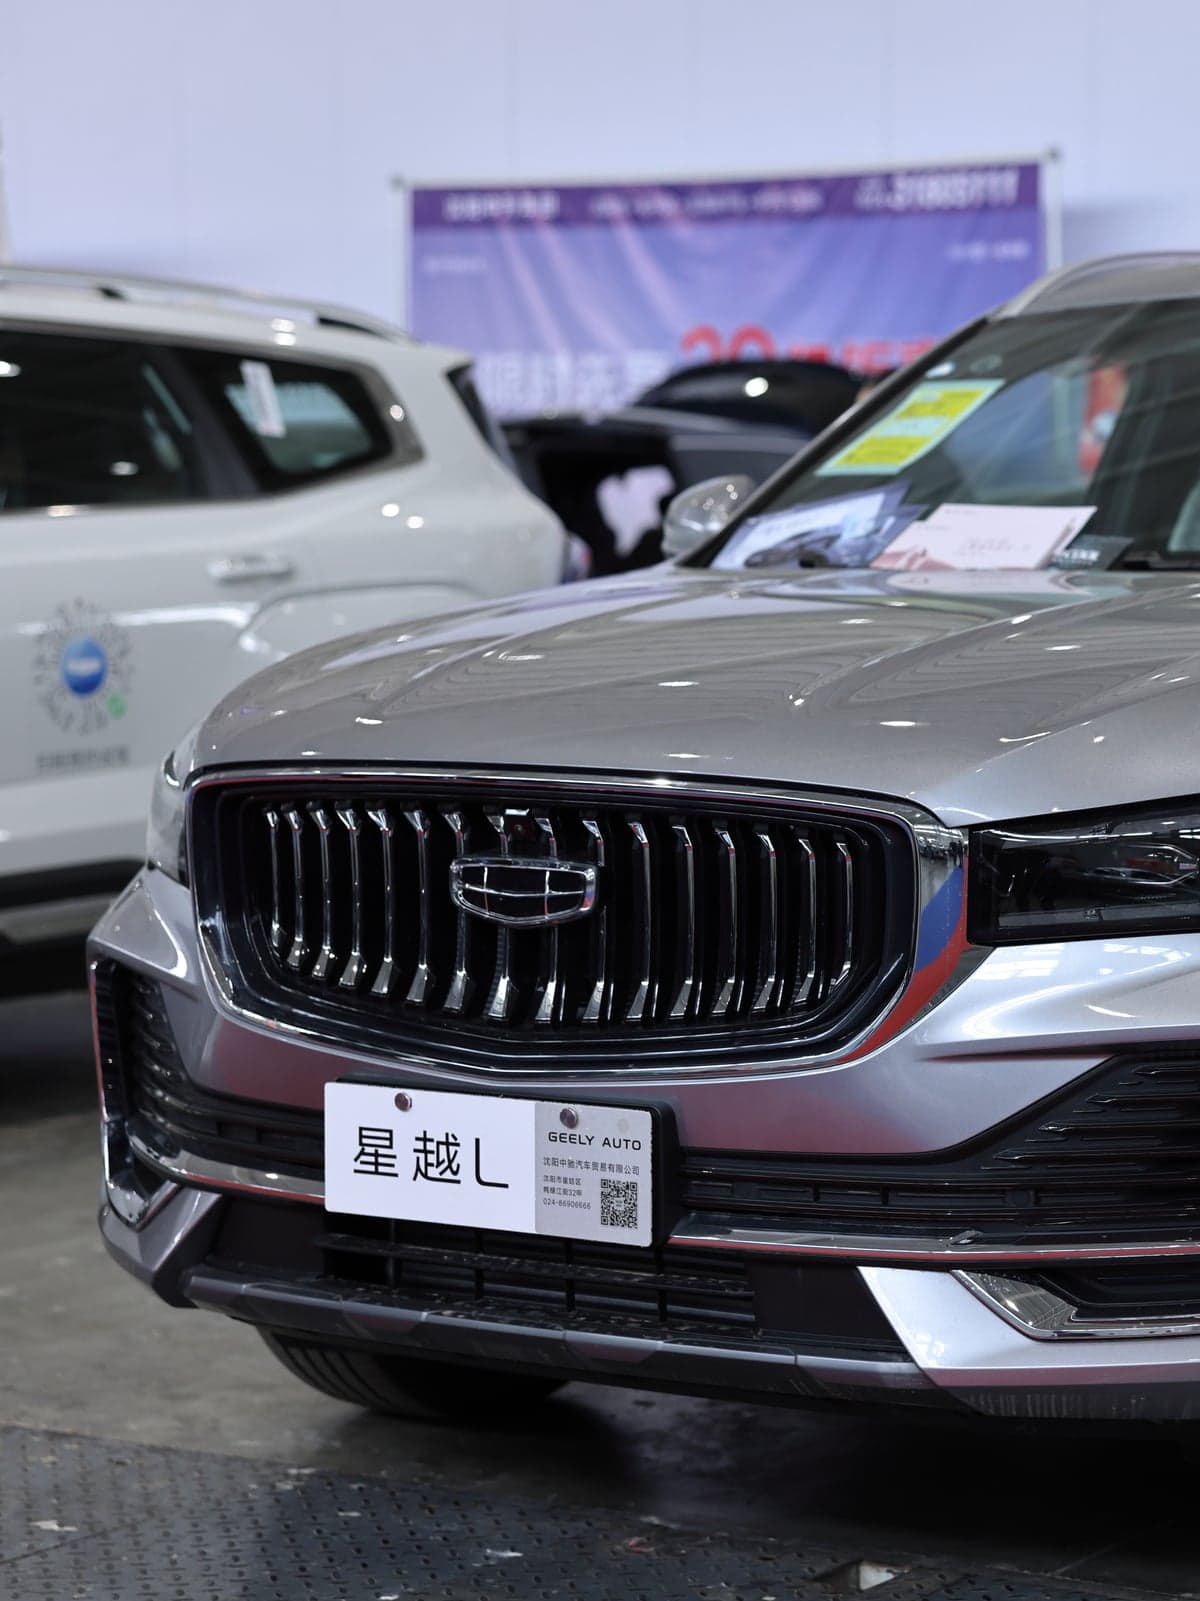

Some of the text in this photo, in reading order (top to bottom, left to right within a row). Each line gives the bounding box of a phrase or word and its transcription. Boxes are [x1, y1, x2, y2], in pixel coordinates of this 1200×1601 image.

[353, 1126, 509, 1190] 星越L
[548, 1132, 641, 1151] GEELY AUTO
